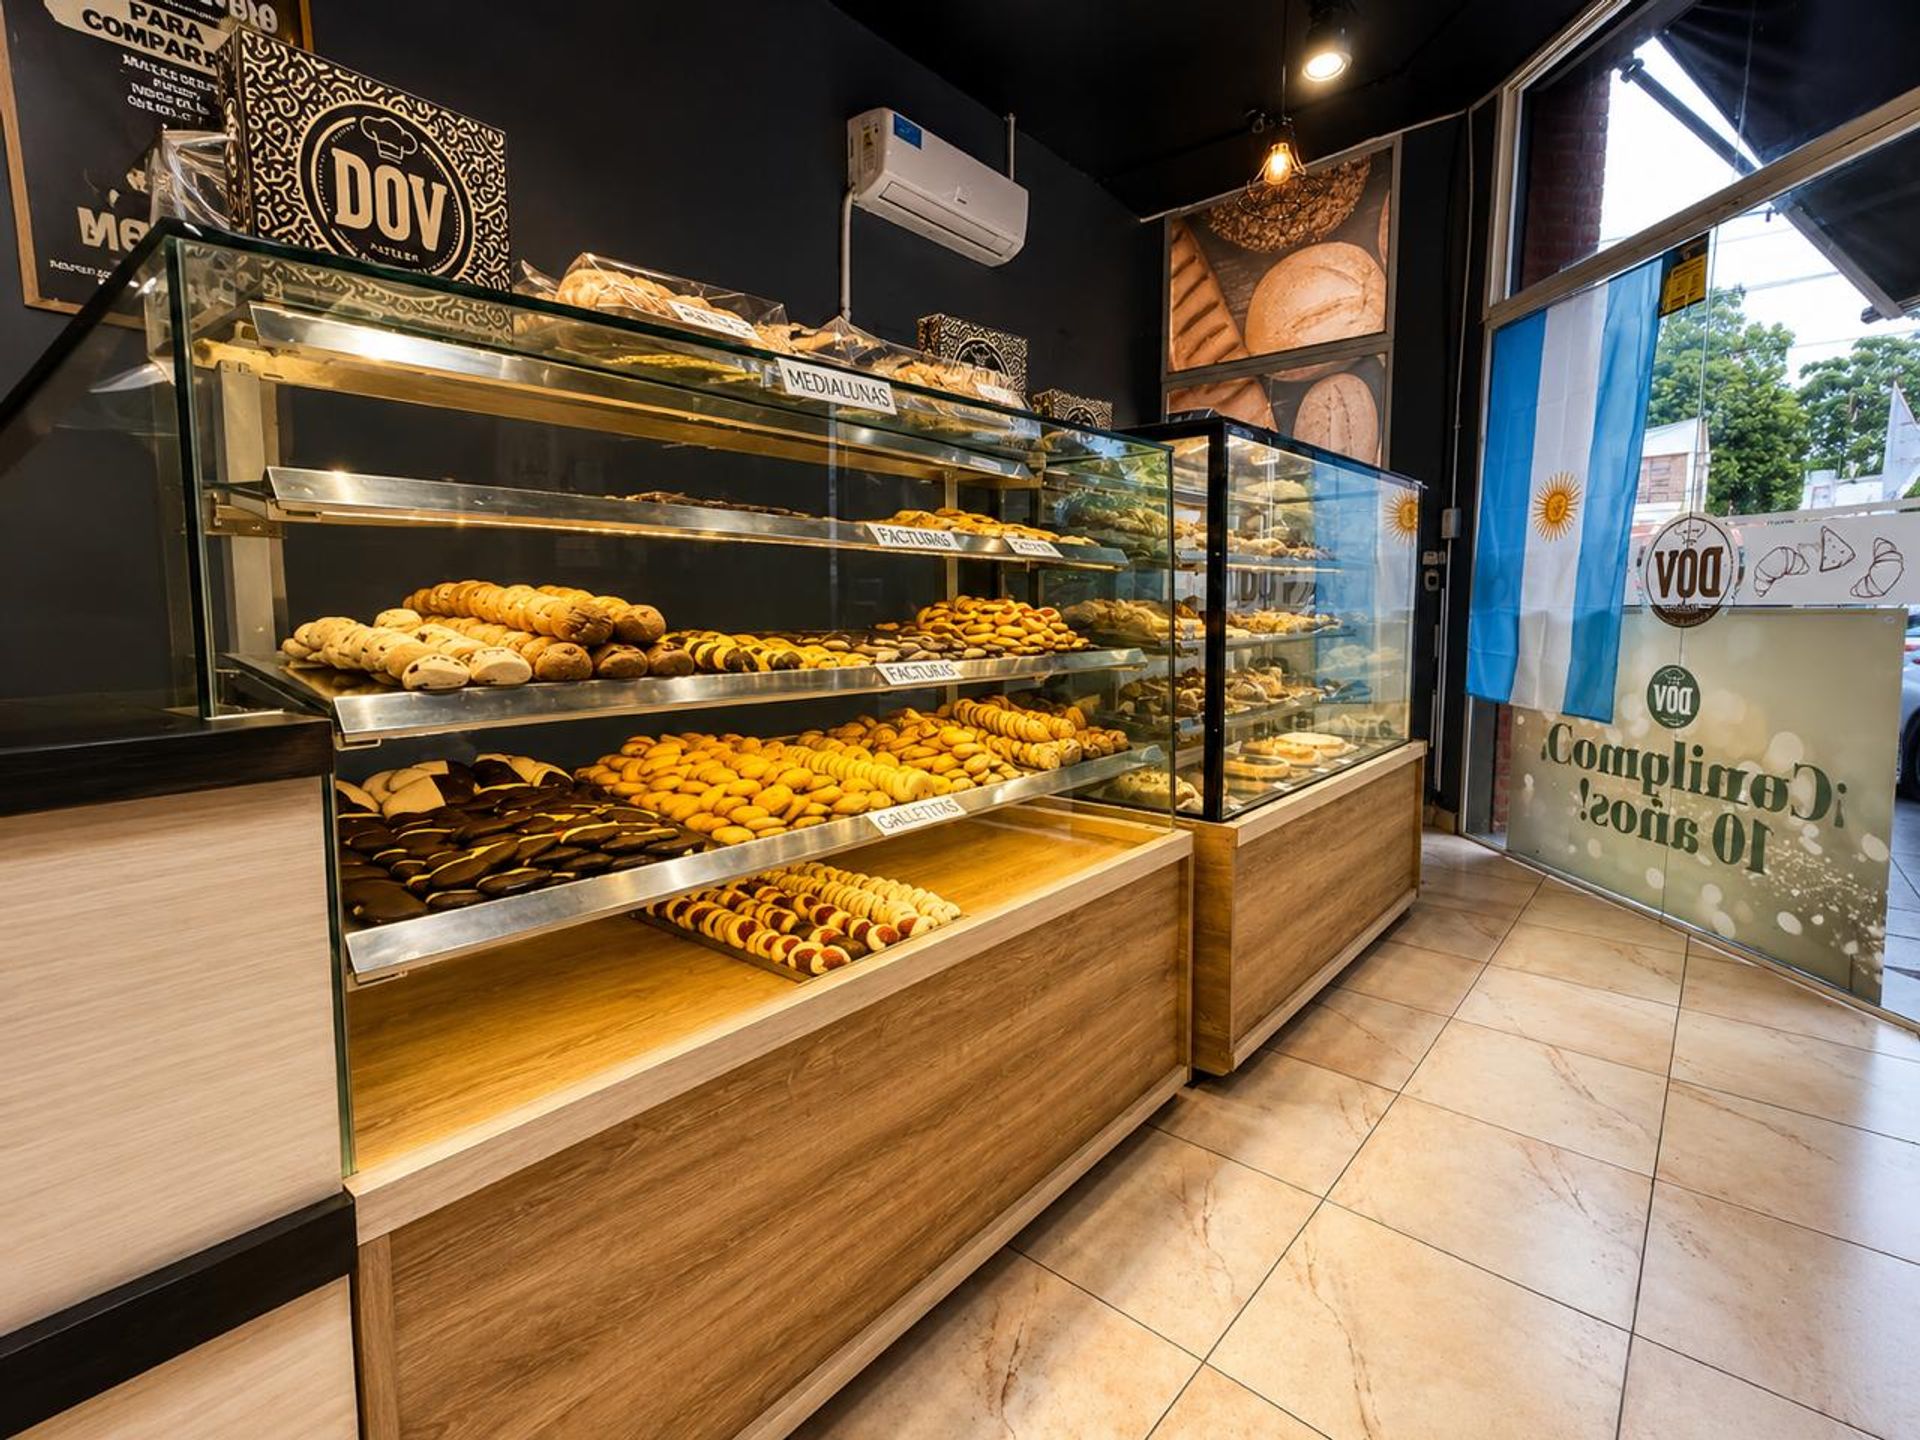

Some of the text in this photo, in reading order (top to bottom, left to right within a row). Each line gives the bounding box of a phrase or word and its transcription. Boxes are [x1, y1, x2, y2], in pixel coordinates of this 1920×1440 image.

[129, 1, 205, 45] PARA
[331, 147, 447, 251] DOV
[787, 369, 890, 408] MEDIALUNAS
